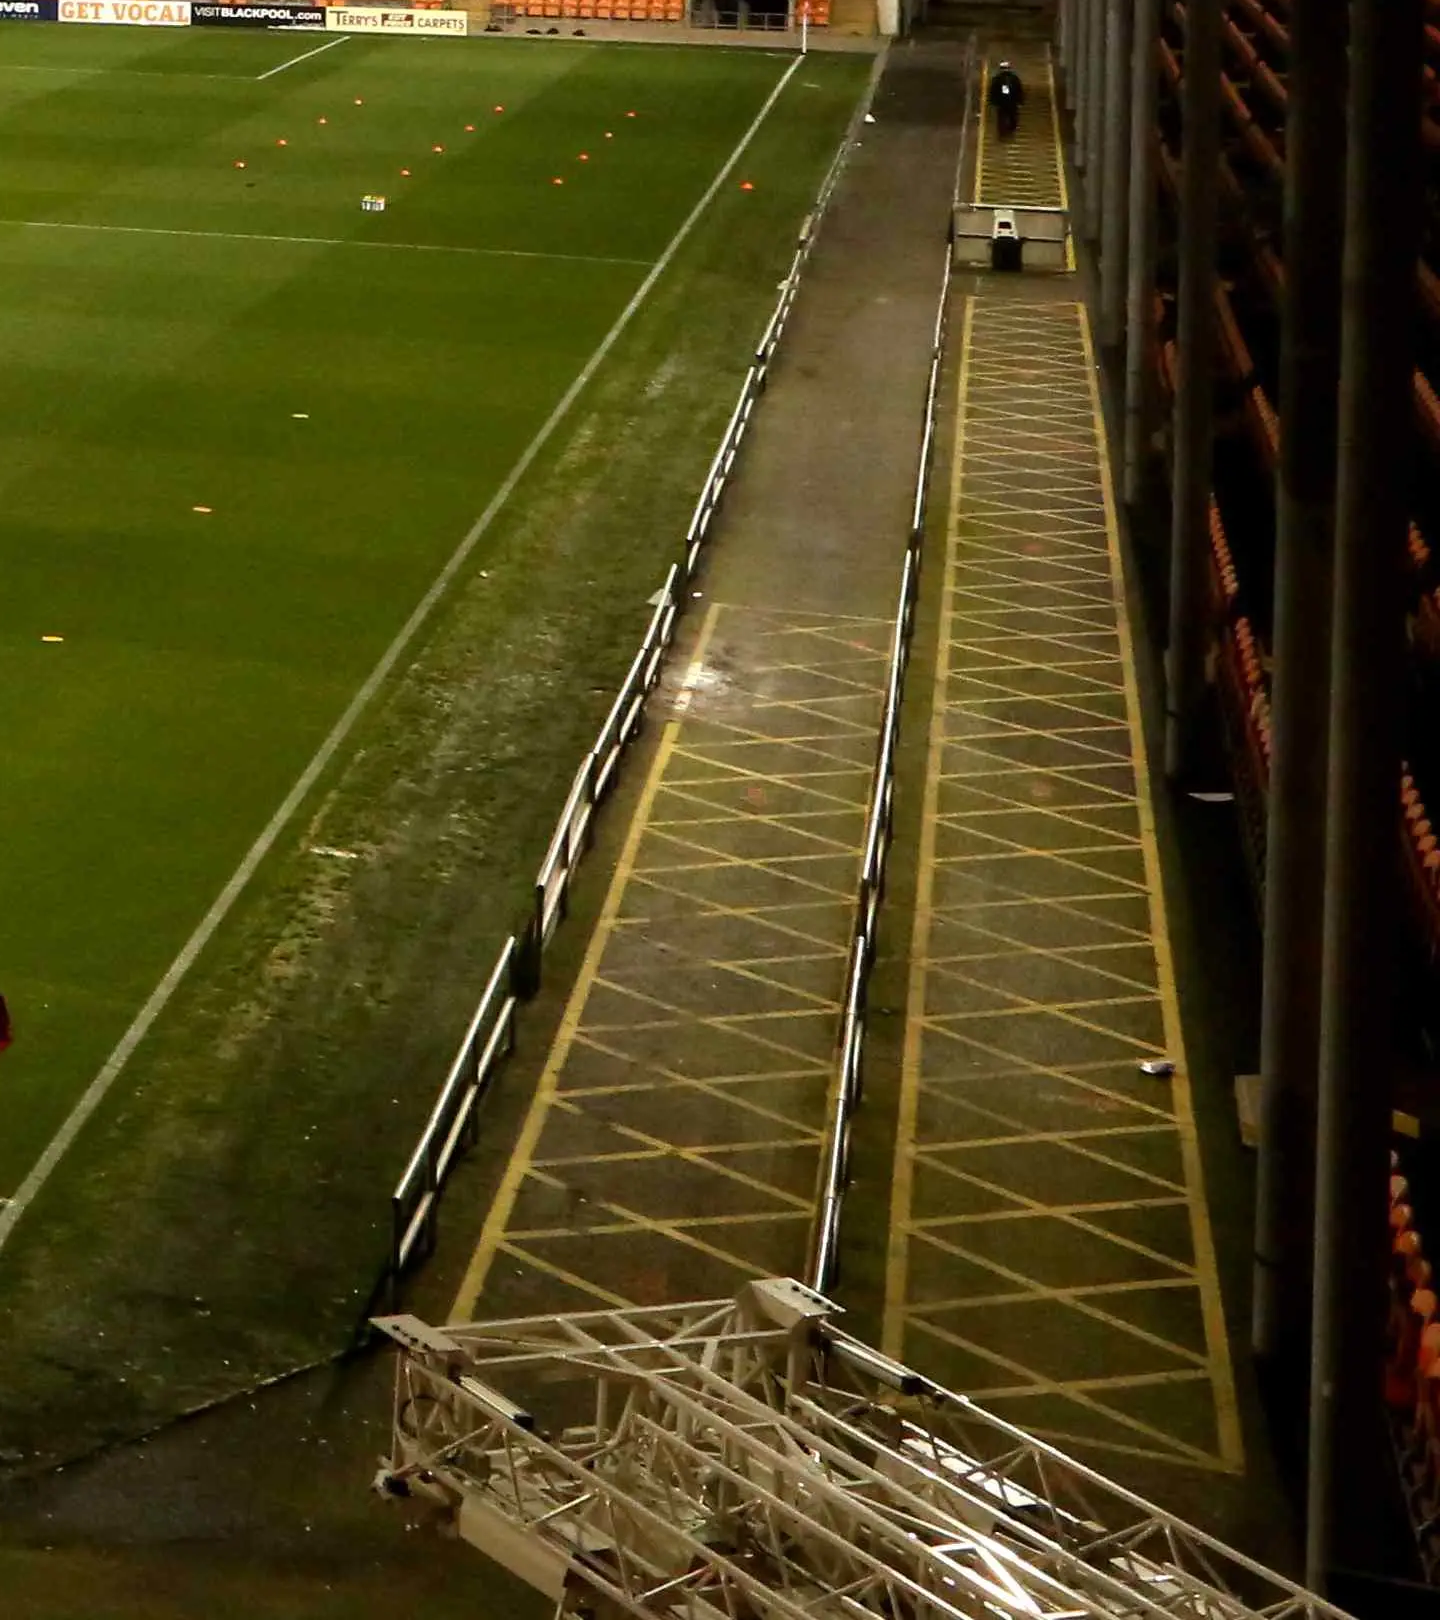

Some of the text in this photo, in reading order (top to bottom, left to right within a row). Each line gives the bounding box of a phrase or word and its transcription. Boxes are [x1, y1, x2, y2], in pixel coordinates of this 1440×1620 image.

[61, 2, 189, 23] GET VOCAL
[194, 7, 323, 21] VISITBLACKPOOL.com
[330, 10, 465, 29] TERRY'S CARPETS
